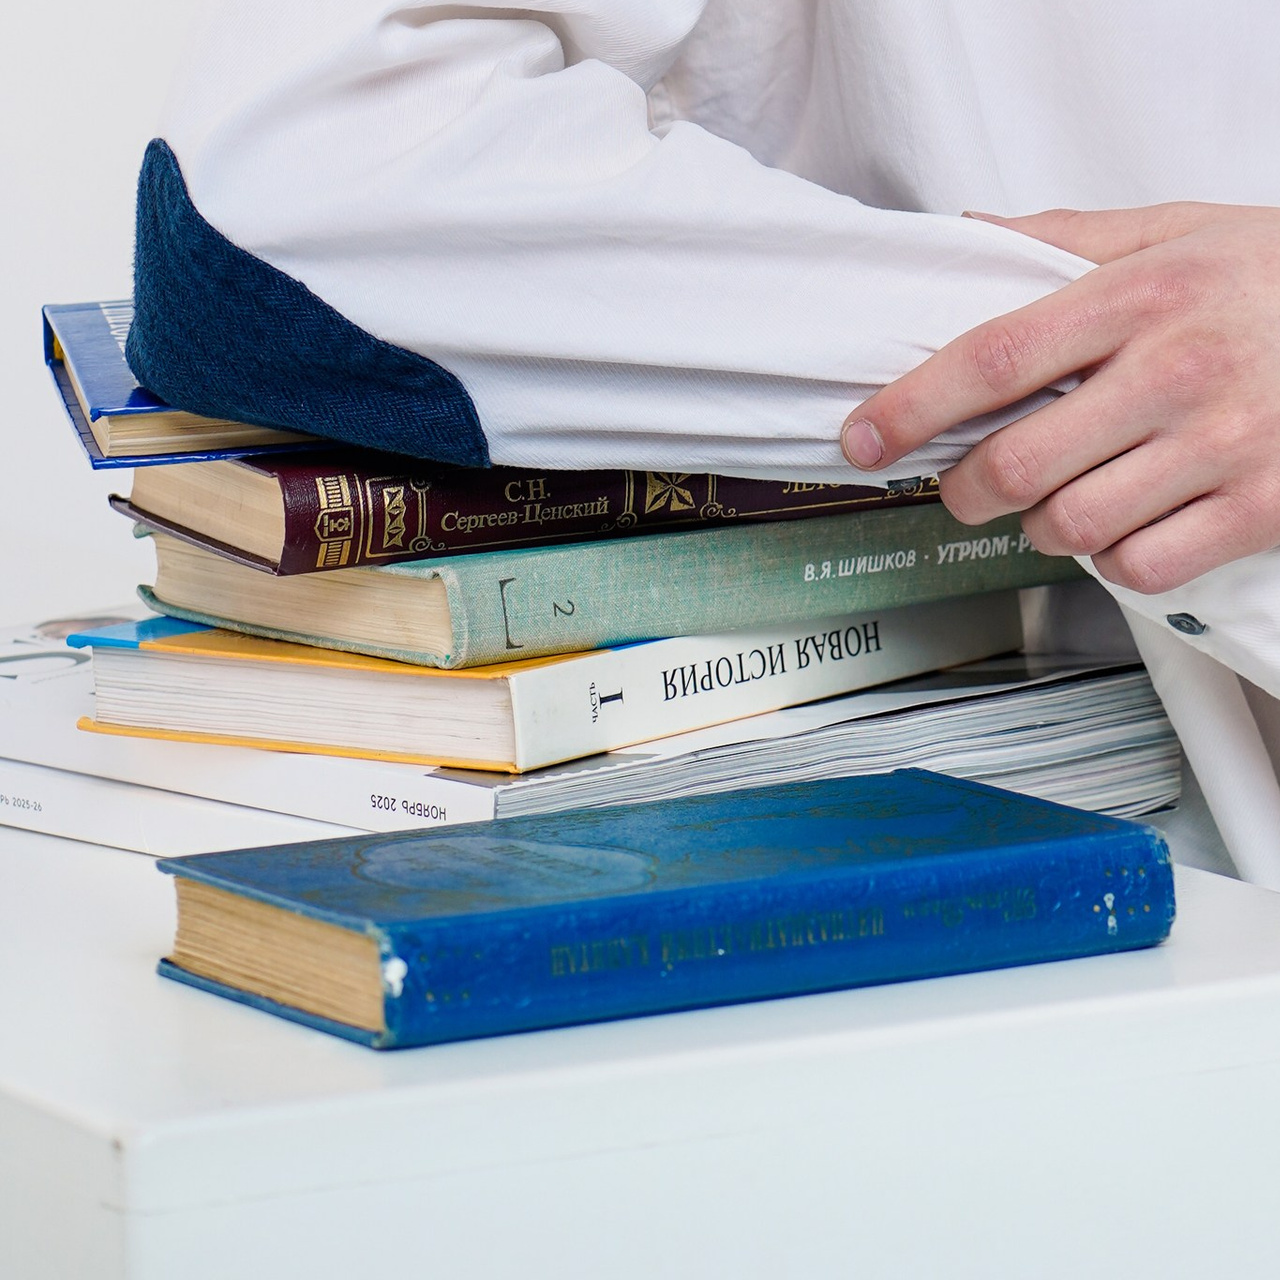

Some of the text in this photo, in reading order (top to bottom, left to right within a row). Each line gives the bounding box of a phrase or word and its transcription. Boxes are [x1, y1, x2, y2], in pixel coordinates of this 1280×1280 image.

[504, 478, 551, 502] С.Н.
[441, 496, 610, 534] Сергеев-Ценский
[937, 531, 1038, 565] УГРЮМ-Р
[552, 599, 575, 617] 2
[660, 621, 882, 702] НОВАЯ ИСТОРИЯ
[589, 682, 599, 724] ЧАСТЬ
[370, 794, 447, 822] НОЯБРЬ 2025
